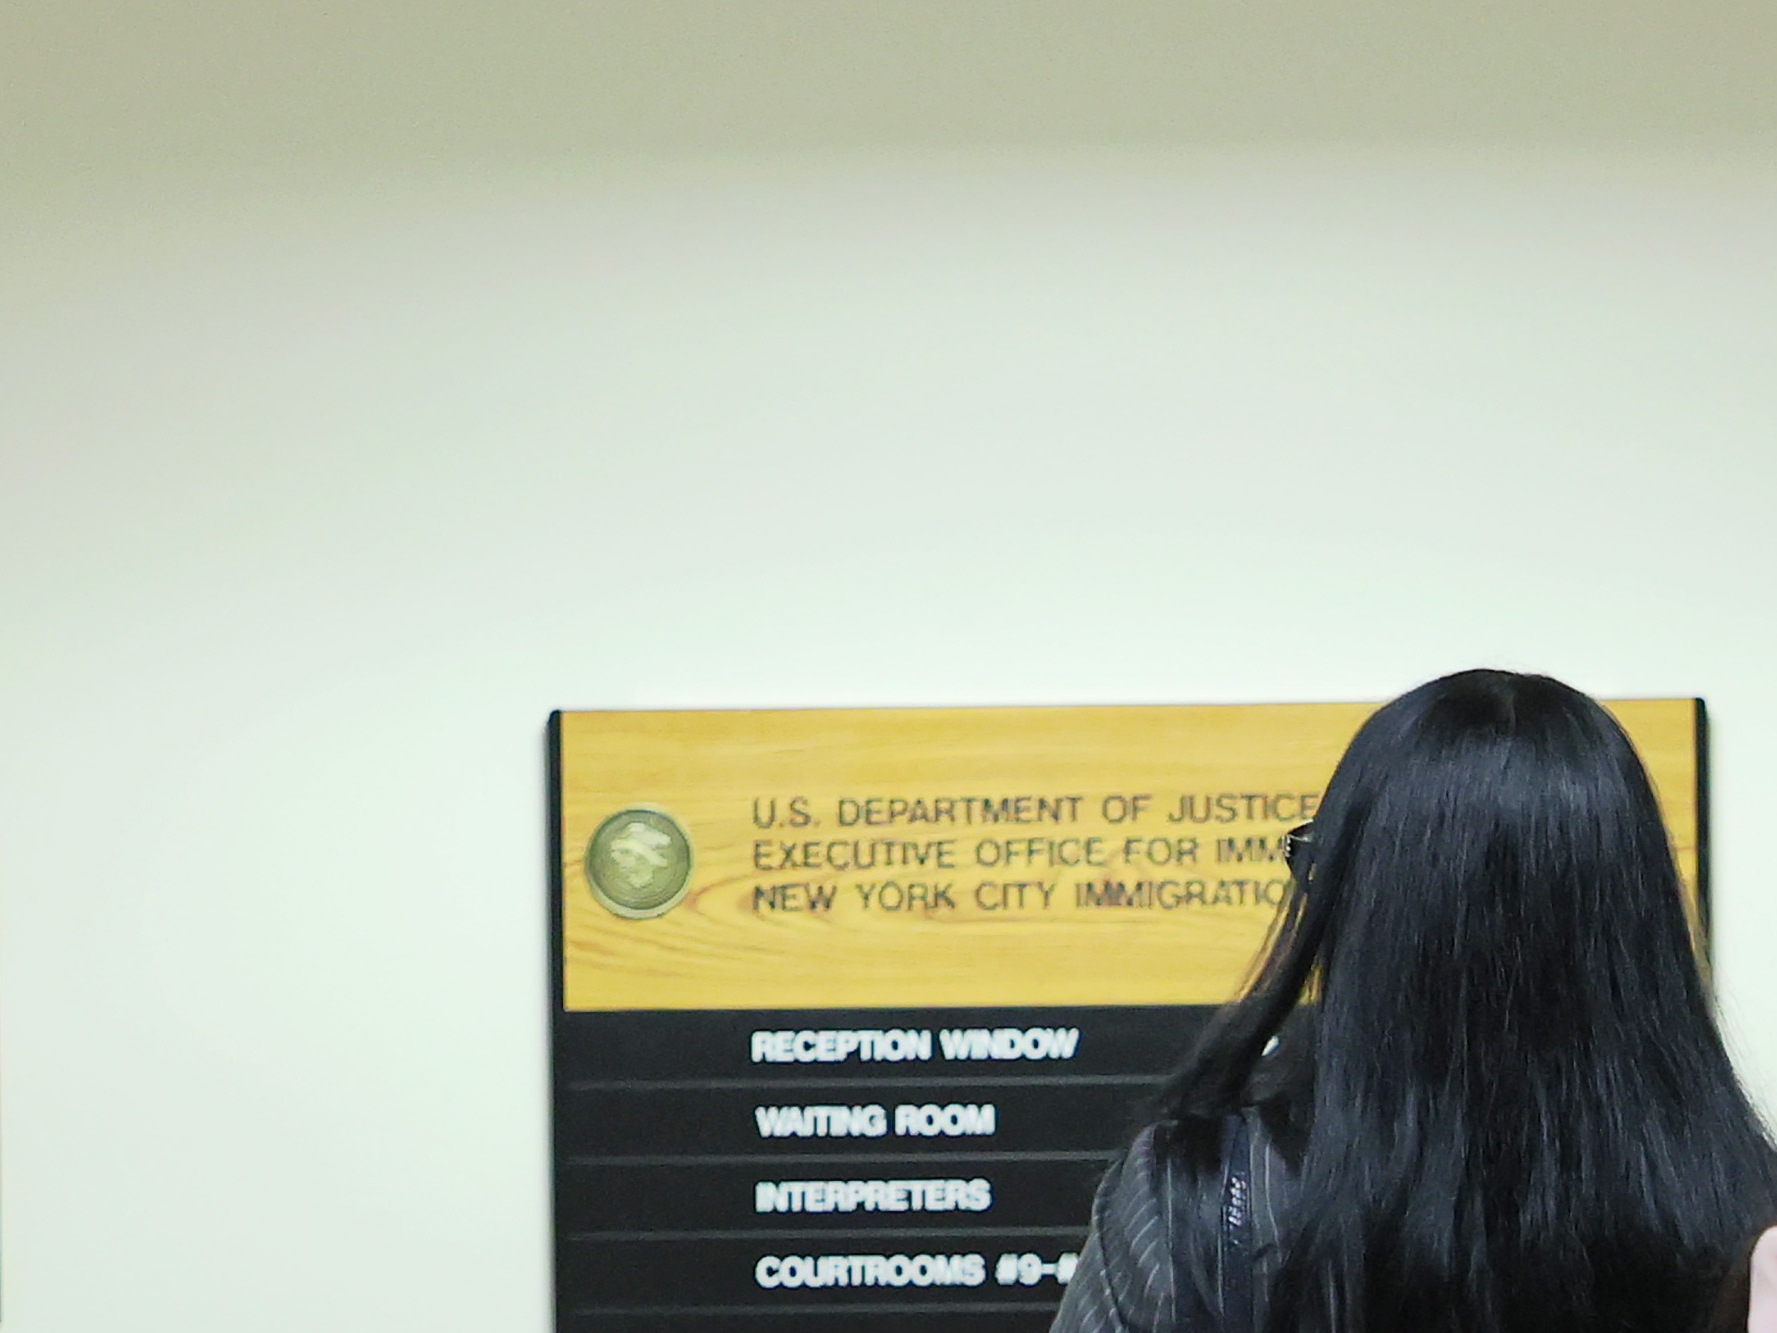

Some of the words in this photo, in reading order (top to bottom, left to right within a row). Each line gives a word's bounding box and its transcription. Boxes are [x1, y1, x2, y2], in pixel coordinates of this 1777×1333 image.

[752, 797, 819, 828] U.S.
[838, 795, 1081, 828] DEPARTMENT
[1102, 794, 1152, 824] OF
[1168, 792, 1320, 823] JUSTICE
[753, 839, 956, 870] EXECUTIVE
[975, 837, 1108, 868] OFFICE
[1125, 836, 1199, 866] FOR
[753, 882, 838, 913] NEW
[856, 880, 956, 912] YORK
[975, 880, 1057, 911] CITY
[751, 1030, 932, 1063] RECEPTION
[938, 1027, 1080, 1061] WINDOW
[755, 1104, 888, 1138] WAITING
[895, 1103, 996, 1136] ROOM
[755, 1178, 991, 1212] INTERPRETERS
[755, 1254, 986, 1288] COURTROOMS
